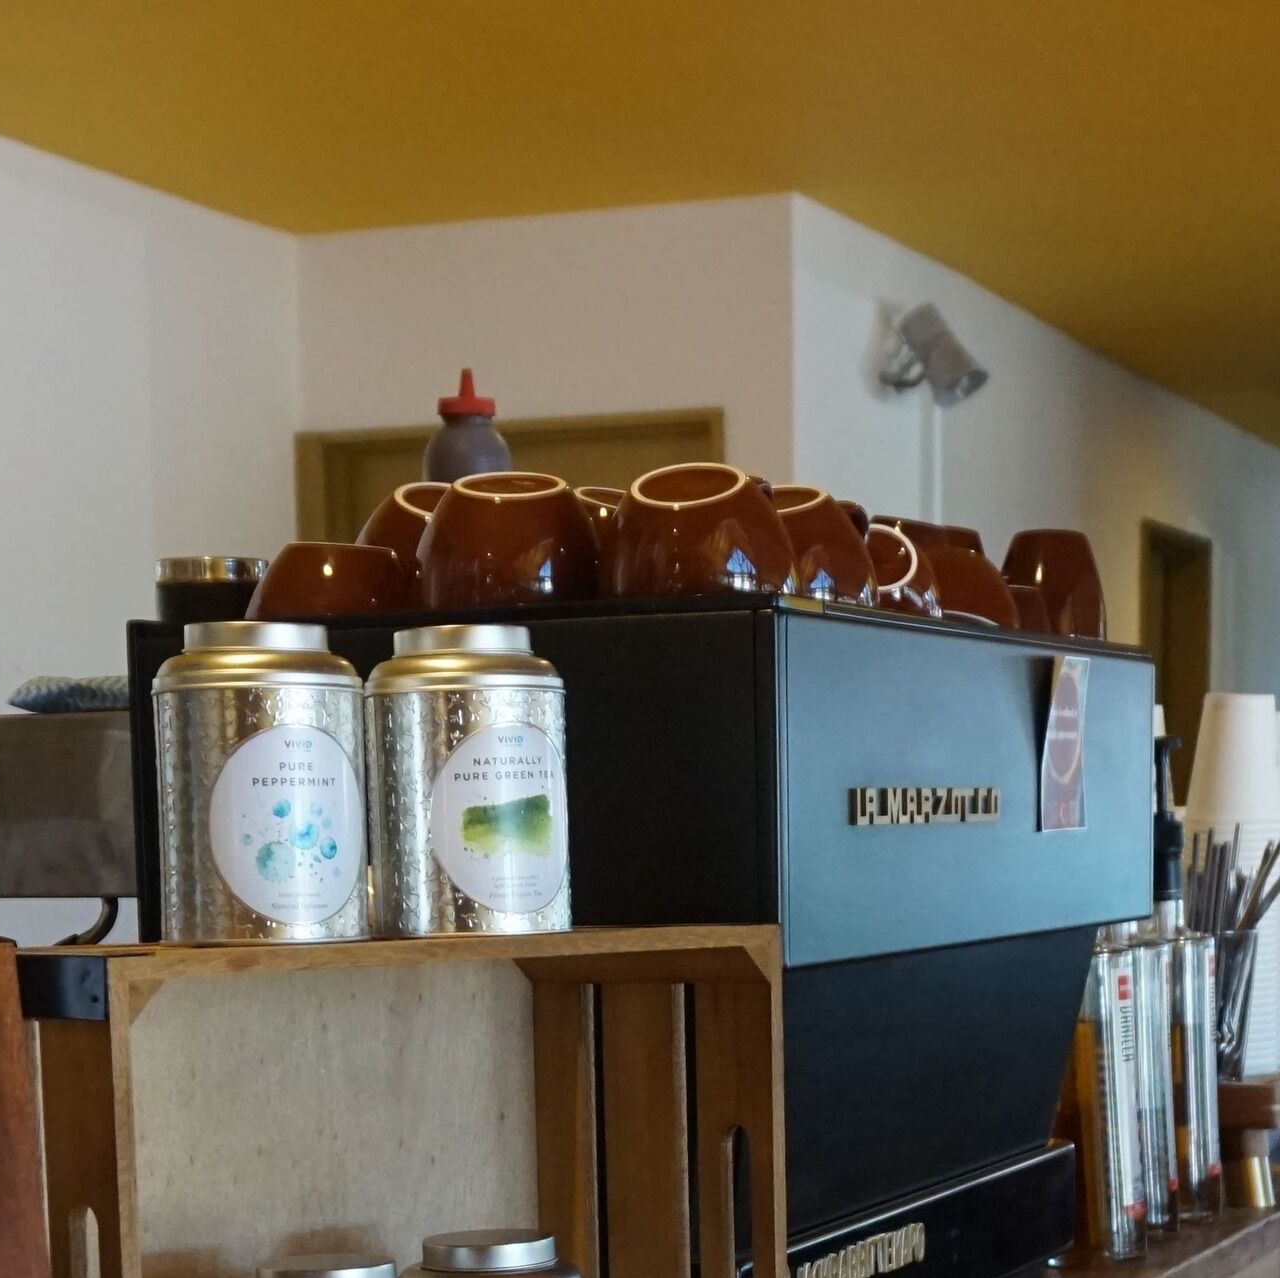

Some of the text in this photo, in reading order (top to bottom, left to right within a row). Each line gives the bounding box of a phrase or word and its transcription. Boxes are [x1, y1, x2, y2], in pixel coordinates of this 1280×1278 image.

[473, 756, 542, 766] NATURALLY
[279, 762, 314, 771] PURE
[454, 770, 554, 781] PURE GREEN TEA
[252, 777, 336, 787] PEPPERMINT
[1119, 1005, 1135, 1062] VANILLA
